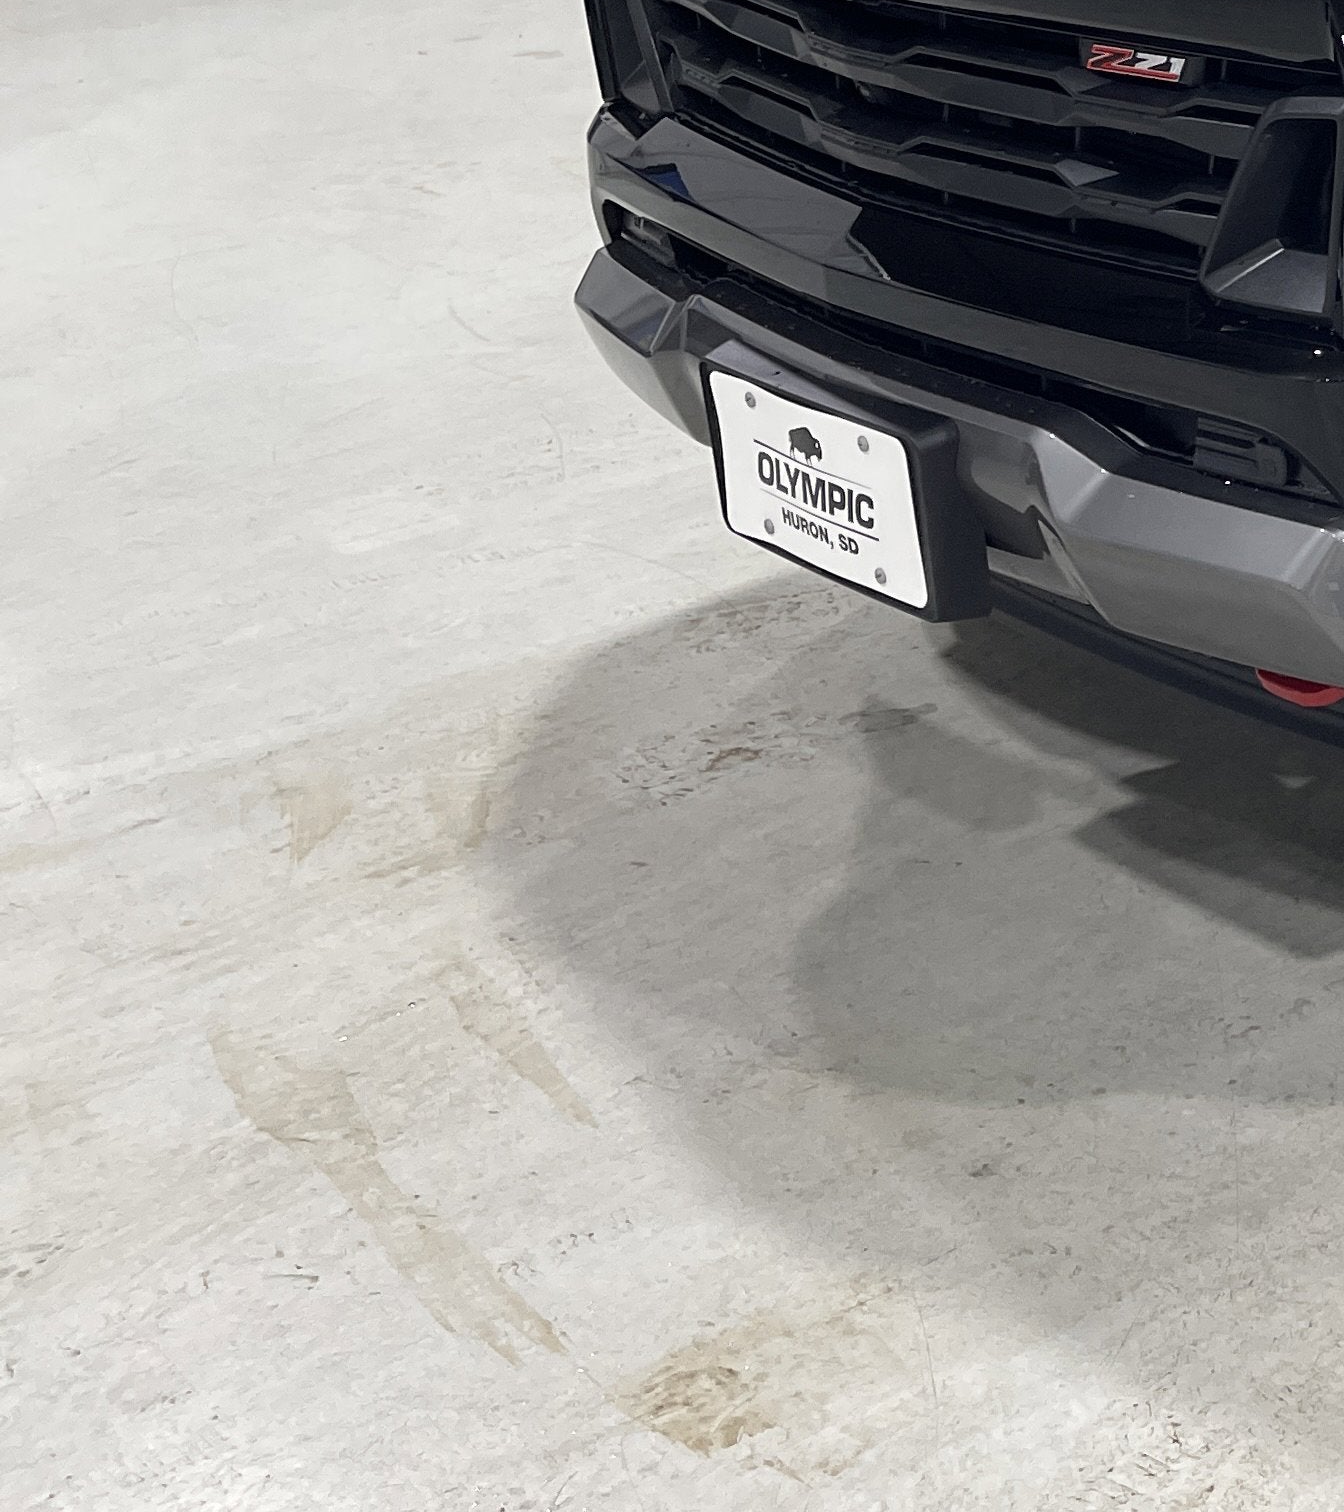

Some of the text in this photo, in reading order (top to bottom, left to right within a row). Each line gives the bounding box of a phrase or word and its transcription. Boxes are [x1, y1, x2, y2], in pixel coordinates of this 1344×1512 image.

[1087, 44, 1186, 83] Z71
[757, 451, 874, 529] OLYMPIC
[782, 507, 859, 555] HURON, SD
